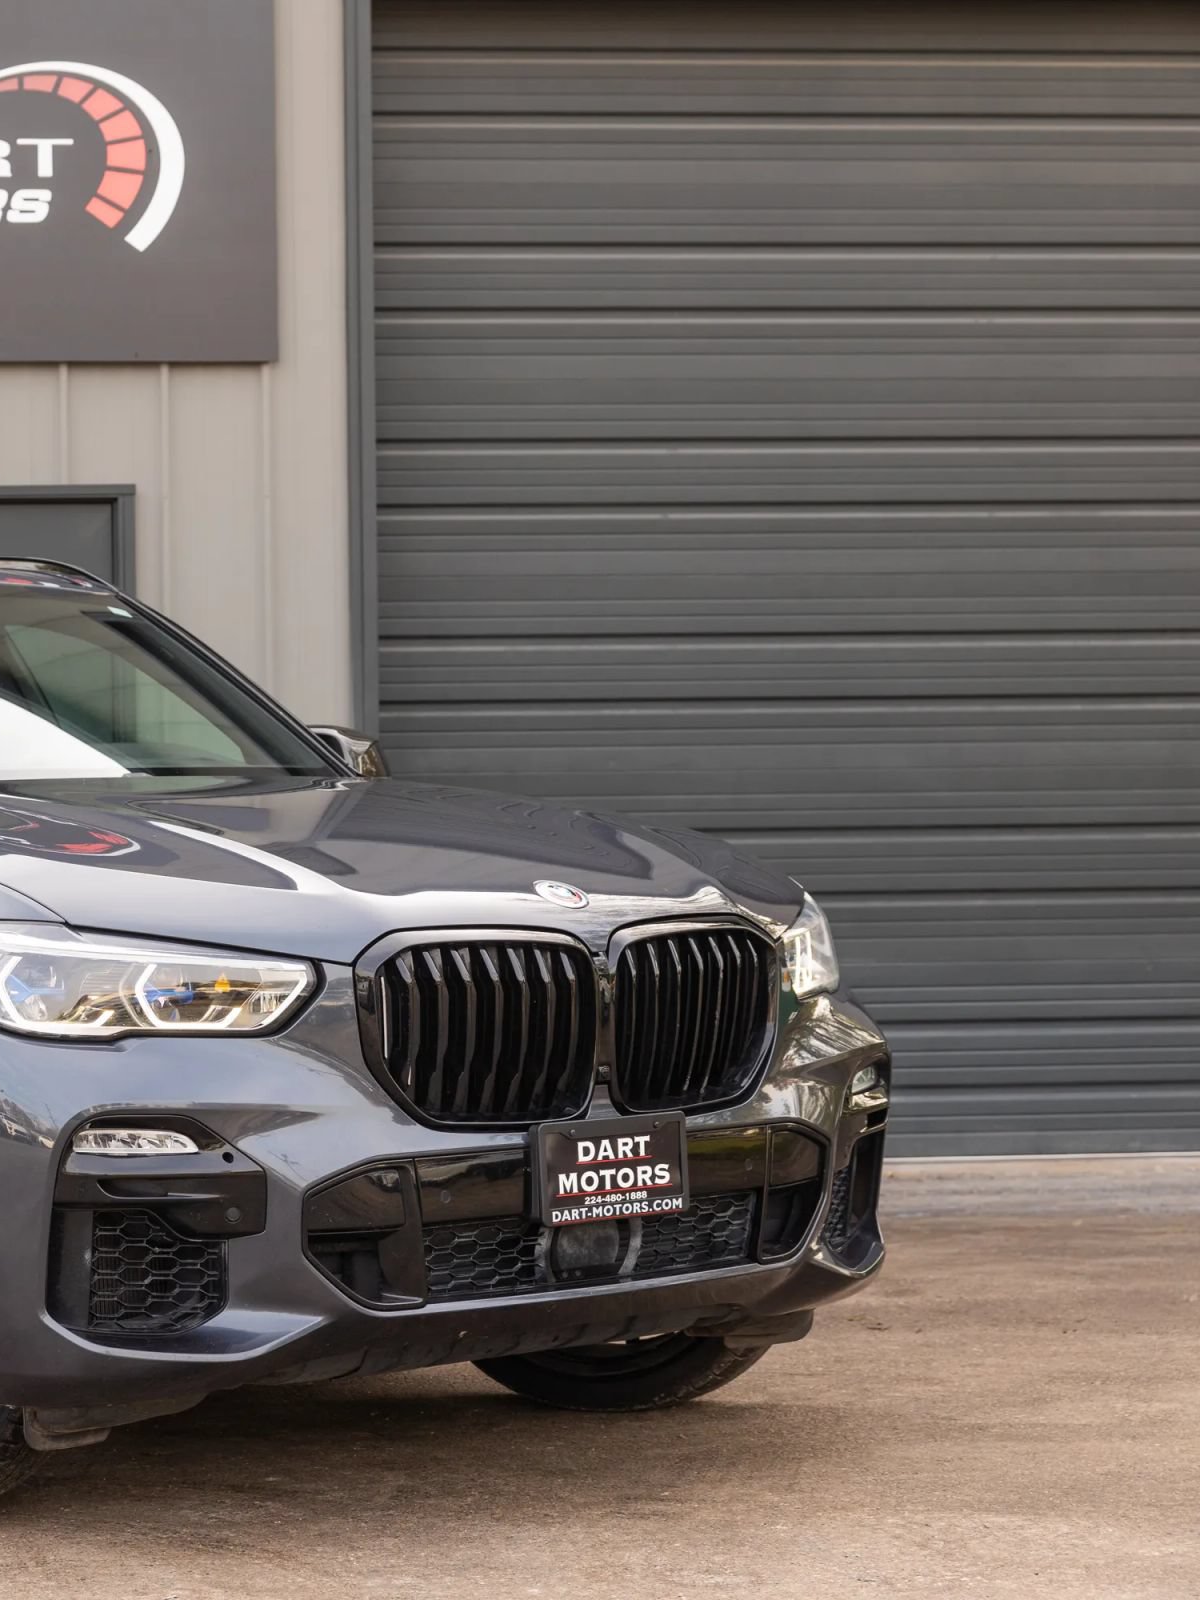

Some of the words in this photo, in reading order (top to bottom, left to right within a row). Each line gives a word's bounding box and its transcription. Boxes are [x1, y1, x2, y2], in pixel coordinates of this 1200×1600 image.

[576, 1135, 651, 1162] DART
[558, 1164, 671, 1195] MOTORS
[552, 1198, 682, 1223] DART-MOTORS.COM
[584, 1190, 648, 1205] 224-480-1888
